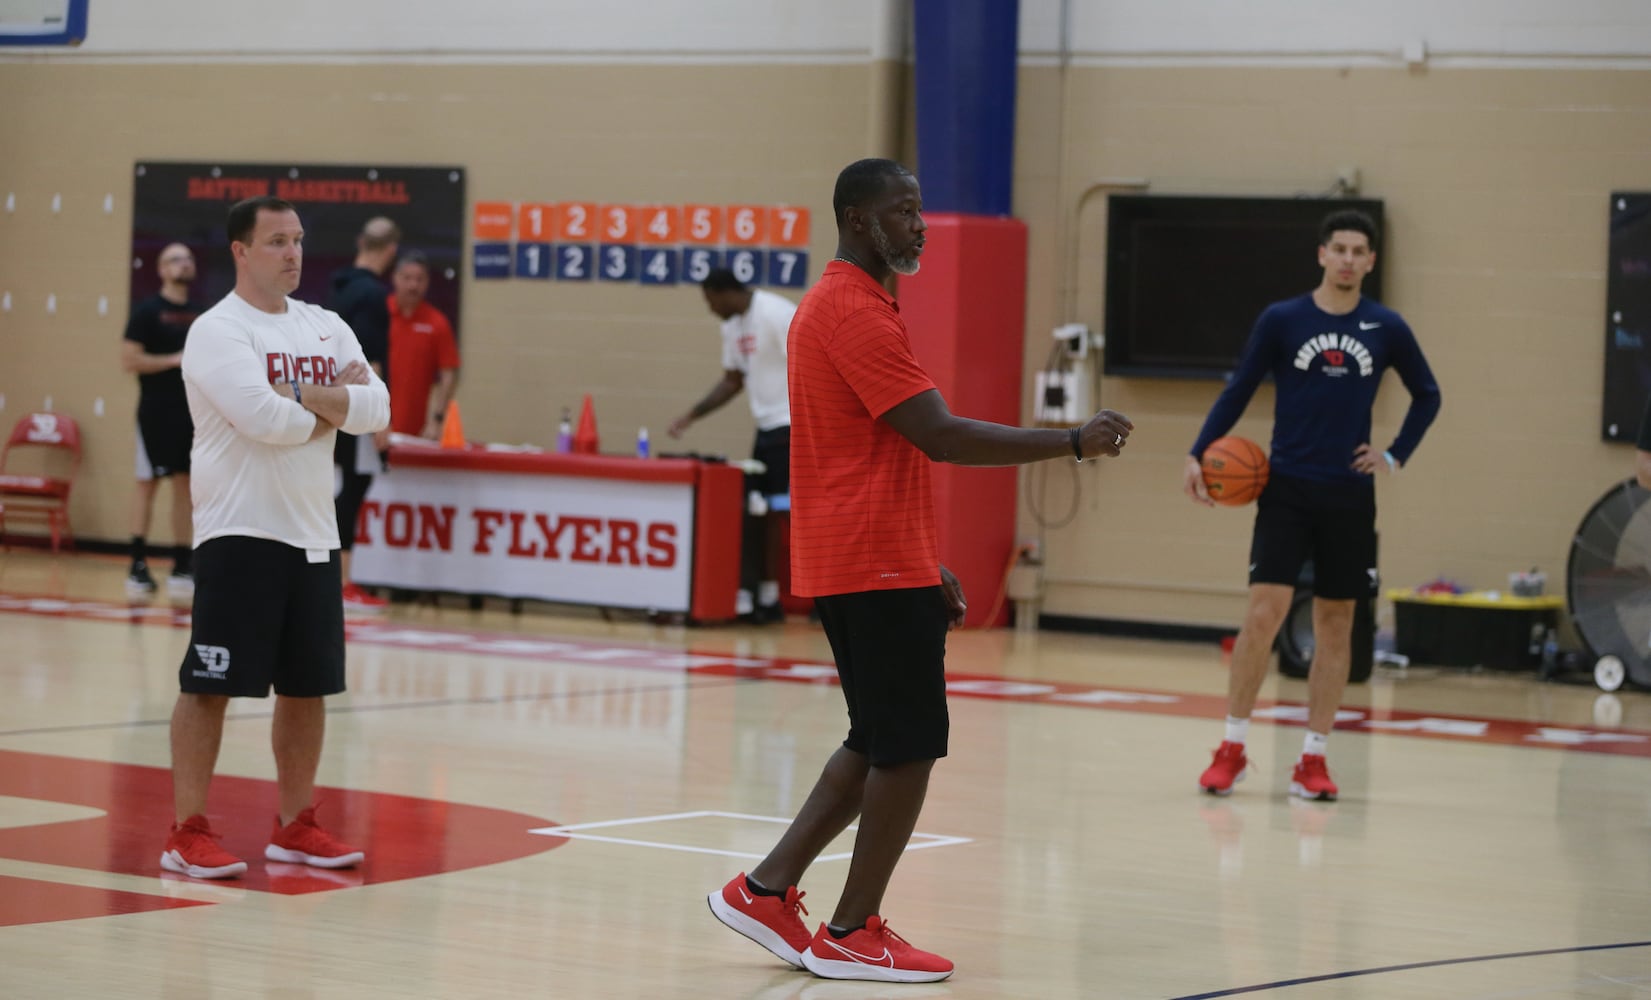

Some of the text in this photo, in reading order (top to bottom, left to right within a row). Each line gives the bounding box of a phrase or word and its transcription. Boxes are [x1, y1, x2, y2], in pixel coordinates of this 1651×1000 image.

[188, 177, 409, 204] DAYTON BASKETBALL
[529, 206, 798, 241] 1 2 3 4 5 6 7
[526, 246, 797, 283] 1 2 3 4 5 6 7
[1293, 332, 1373, 377] DAYTON FLYERS
[471, 508, 677, 570] FLYERS
